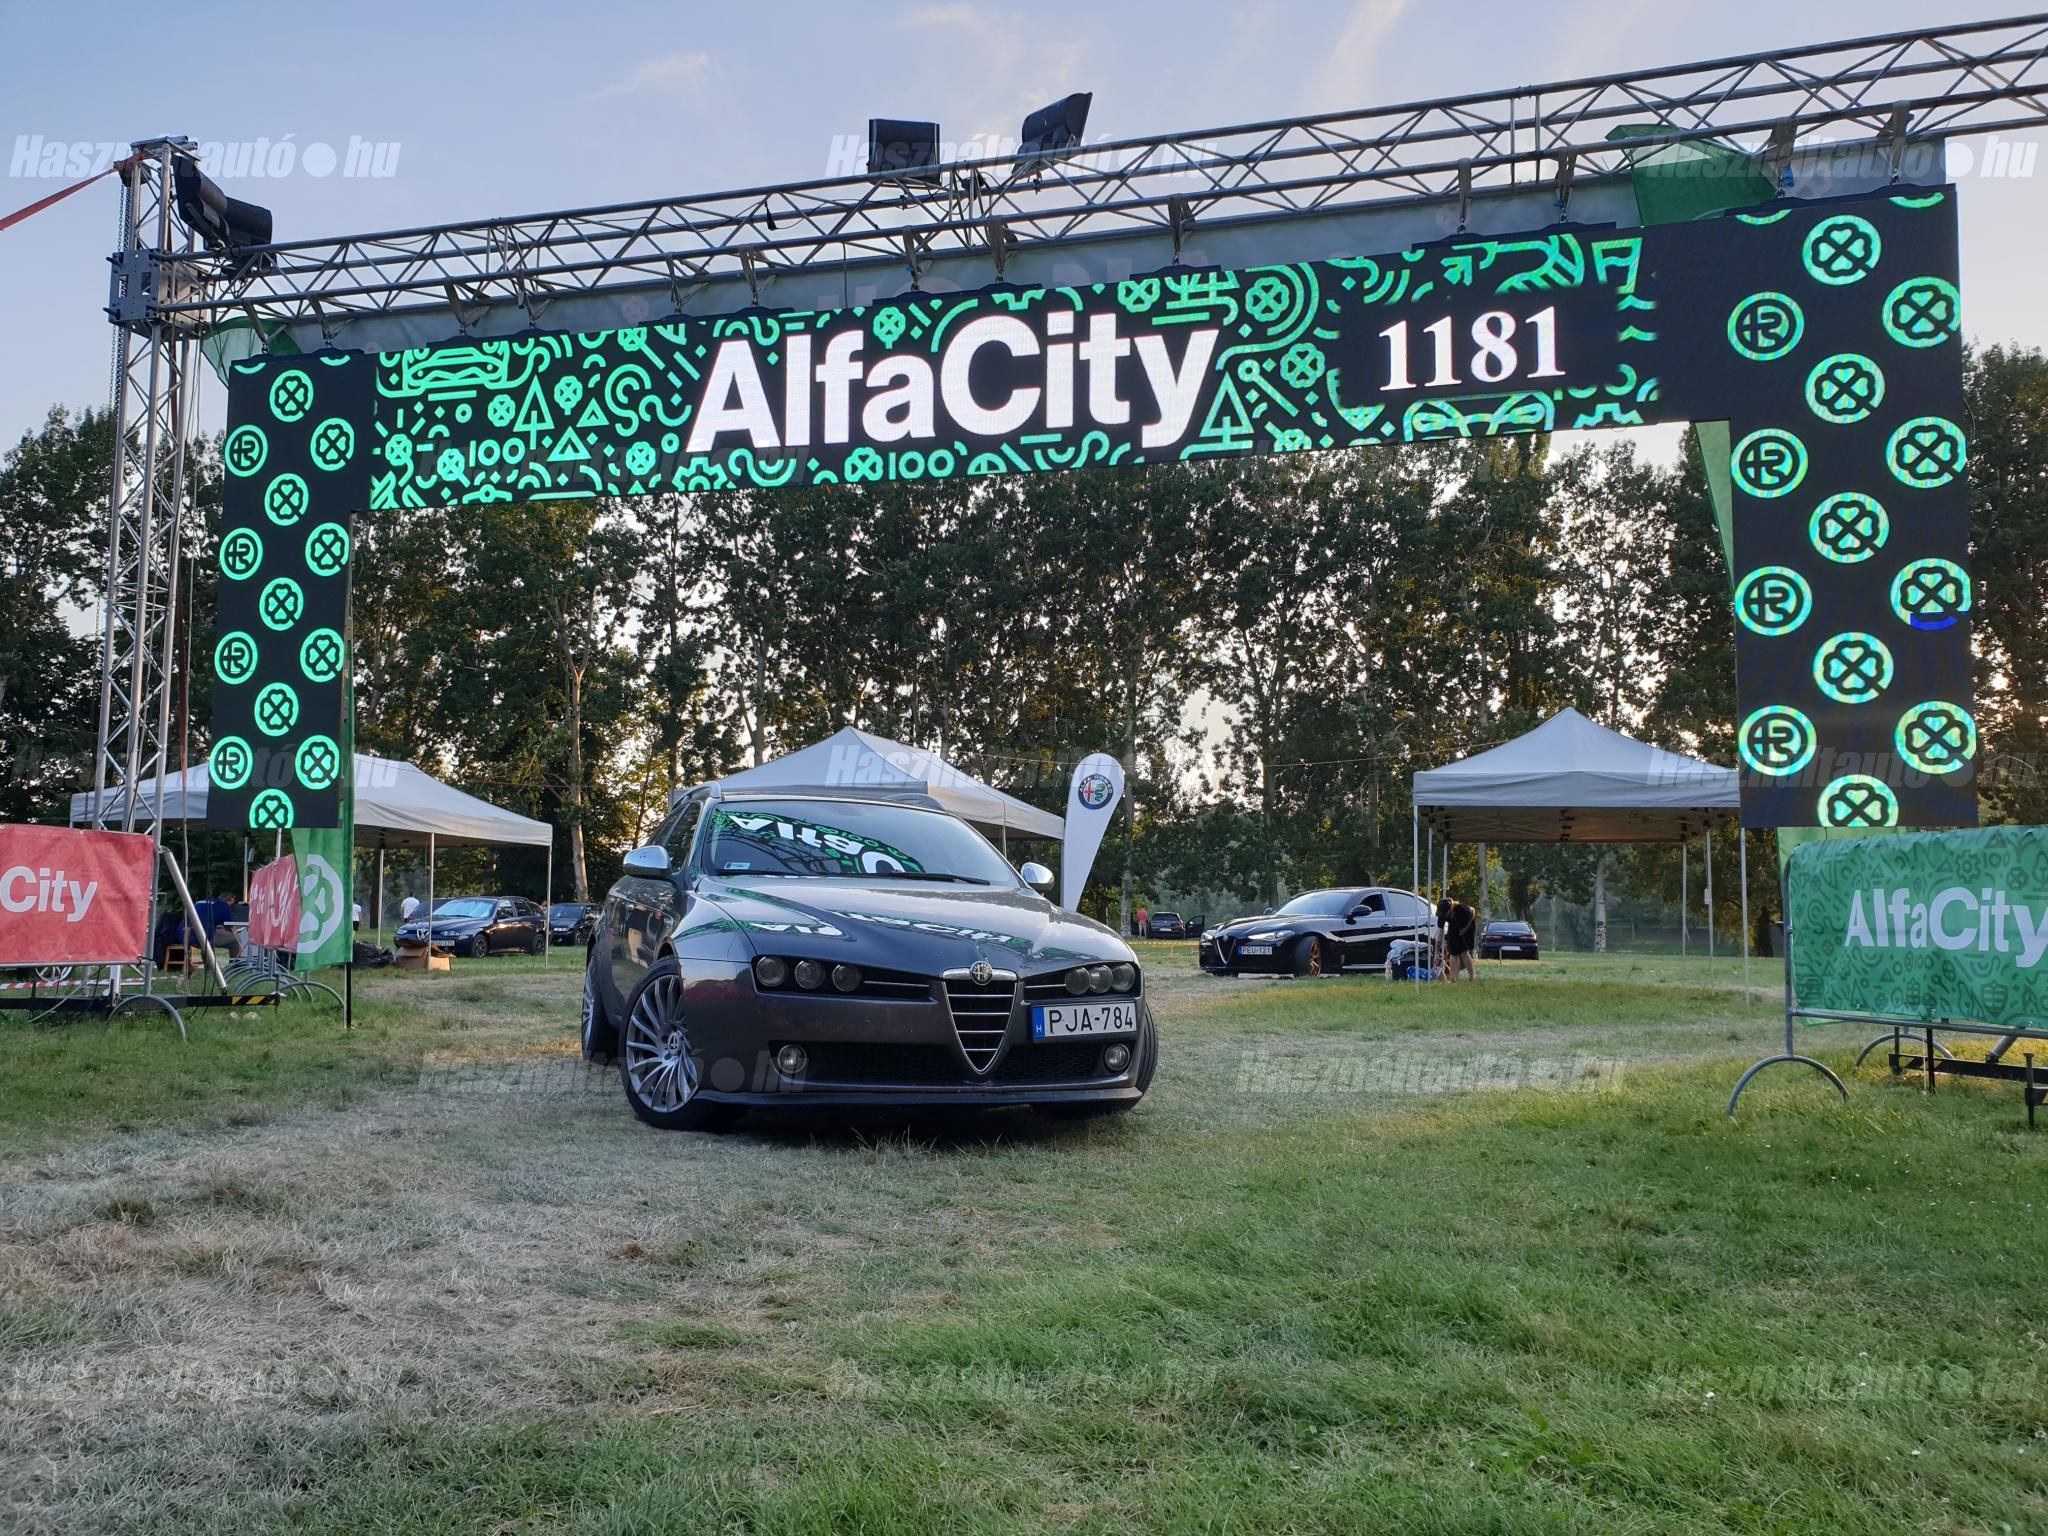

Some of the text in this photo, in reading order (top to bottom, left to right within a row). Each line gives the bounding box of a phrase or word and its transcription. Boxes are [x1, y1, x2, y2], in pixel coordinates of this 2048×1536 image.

[686, 311, 1220, 454] AlfaCity
[1378, 306, 1567, 391] 1181
[1080, 774, 1113, 794] ALFA ROMEO
[0, 865, 98, 923] City
[1845, 886, 2048, 968] AlfaCity
[1035, 1005, 1133, 1035] H PJA-784
